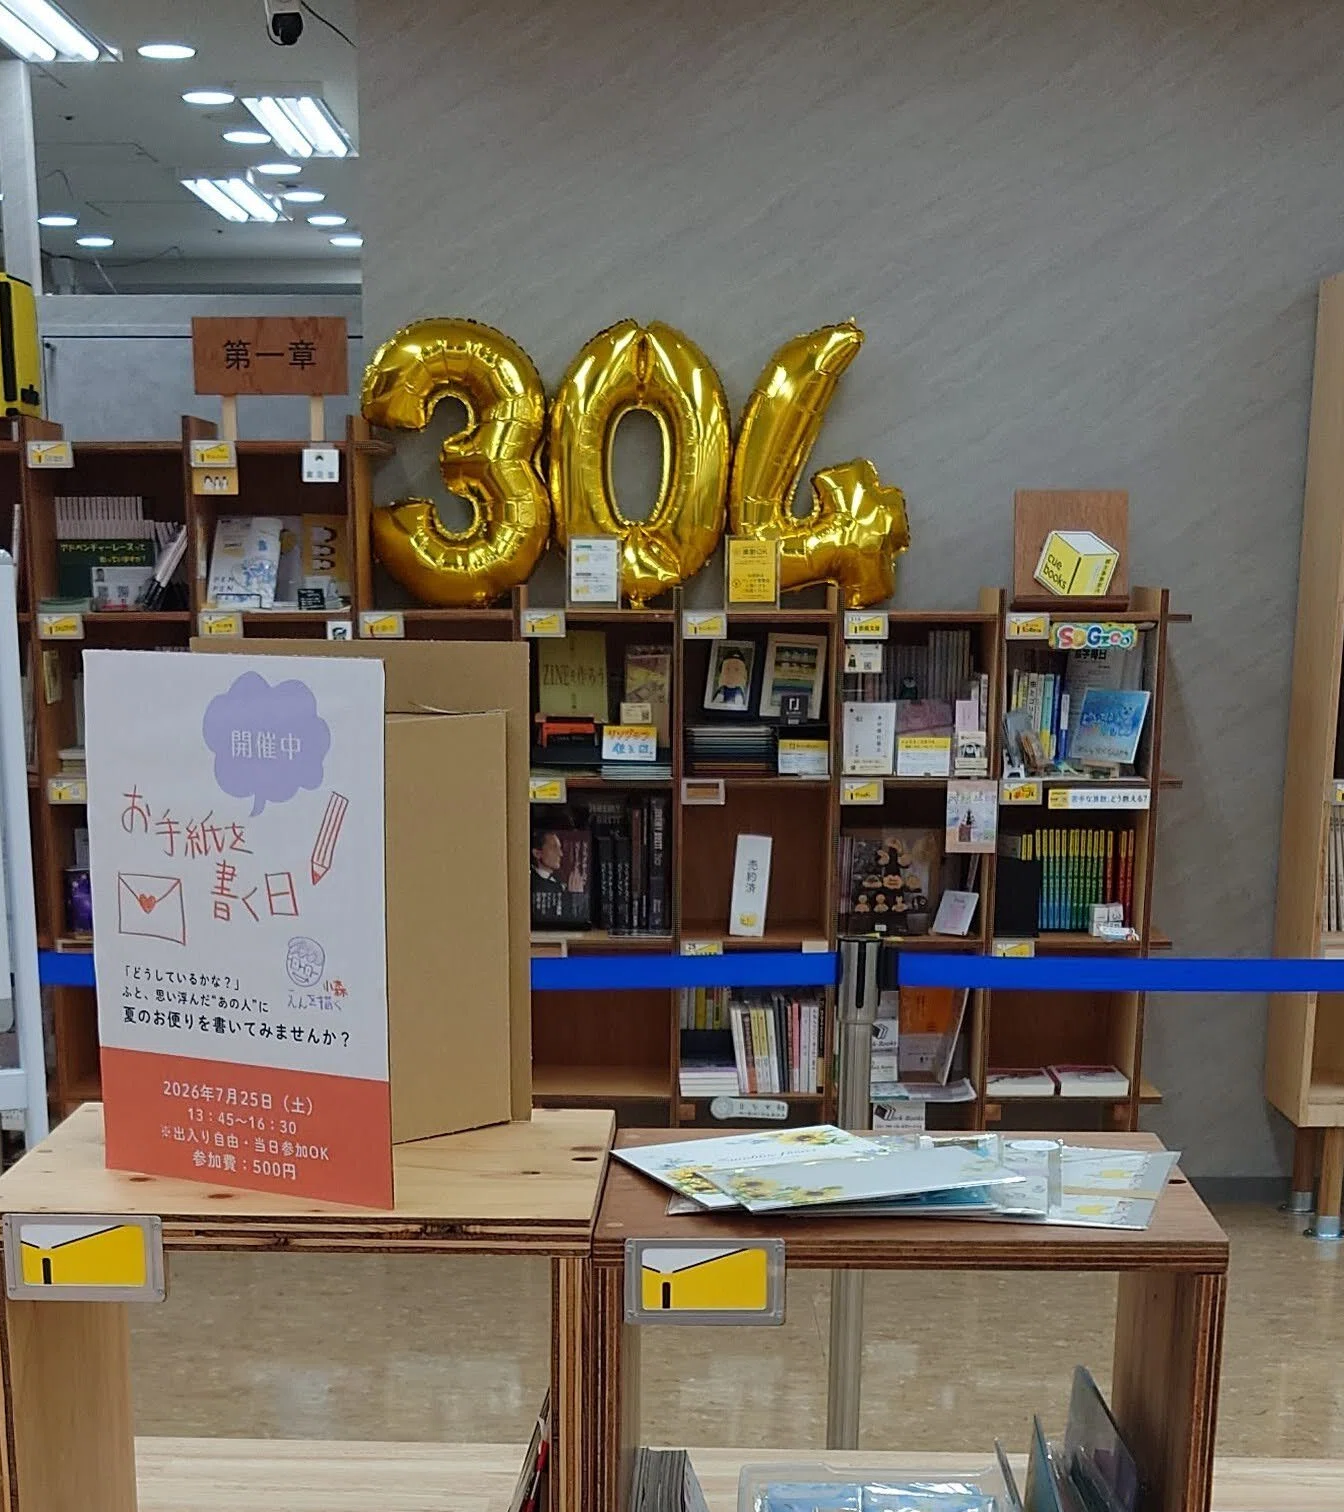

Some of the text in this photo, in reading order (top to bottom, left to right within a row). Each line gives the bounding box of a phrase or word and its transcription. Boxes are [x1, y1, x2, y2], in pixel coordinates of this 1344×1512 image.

[223, 338, 317, 372] 第一章
[1043, 565, 1067, 590] books
[1047, 552, 1063, 571] cue
[230, 730, 302, 761] 開催中
[121, 784, 254, 859] お手紙を
[209, 859, 300, 922] 書く日
[745, 858, 759, 894] 売約済
[123, 964, 241, 991] 「どうしているかな？」
[122, 1007, 351, 1048] 夏のお便りを書いてみませんか？
[163, 1080, 315, 1116] 2026年7月25日（土）
[160, 1125, 330, 1162] ※出入り自由・当日参加OK
[192, 1150, 297, 1182] 参加費：500円
